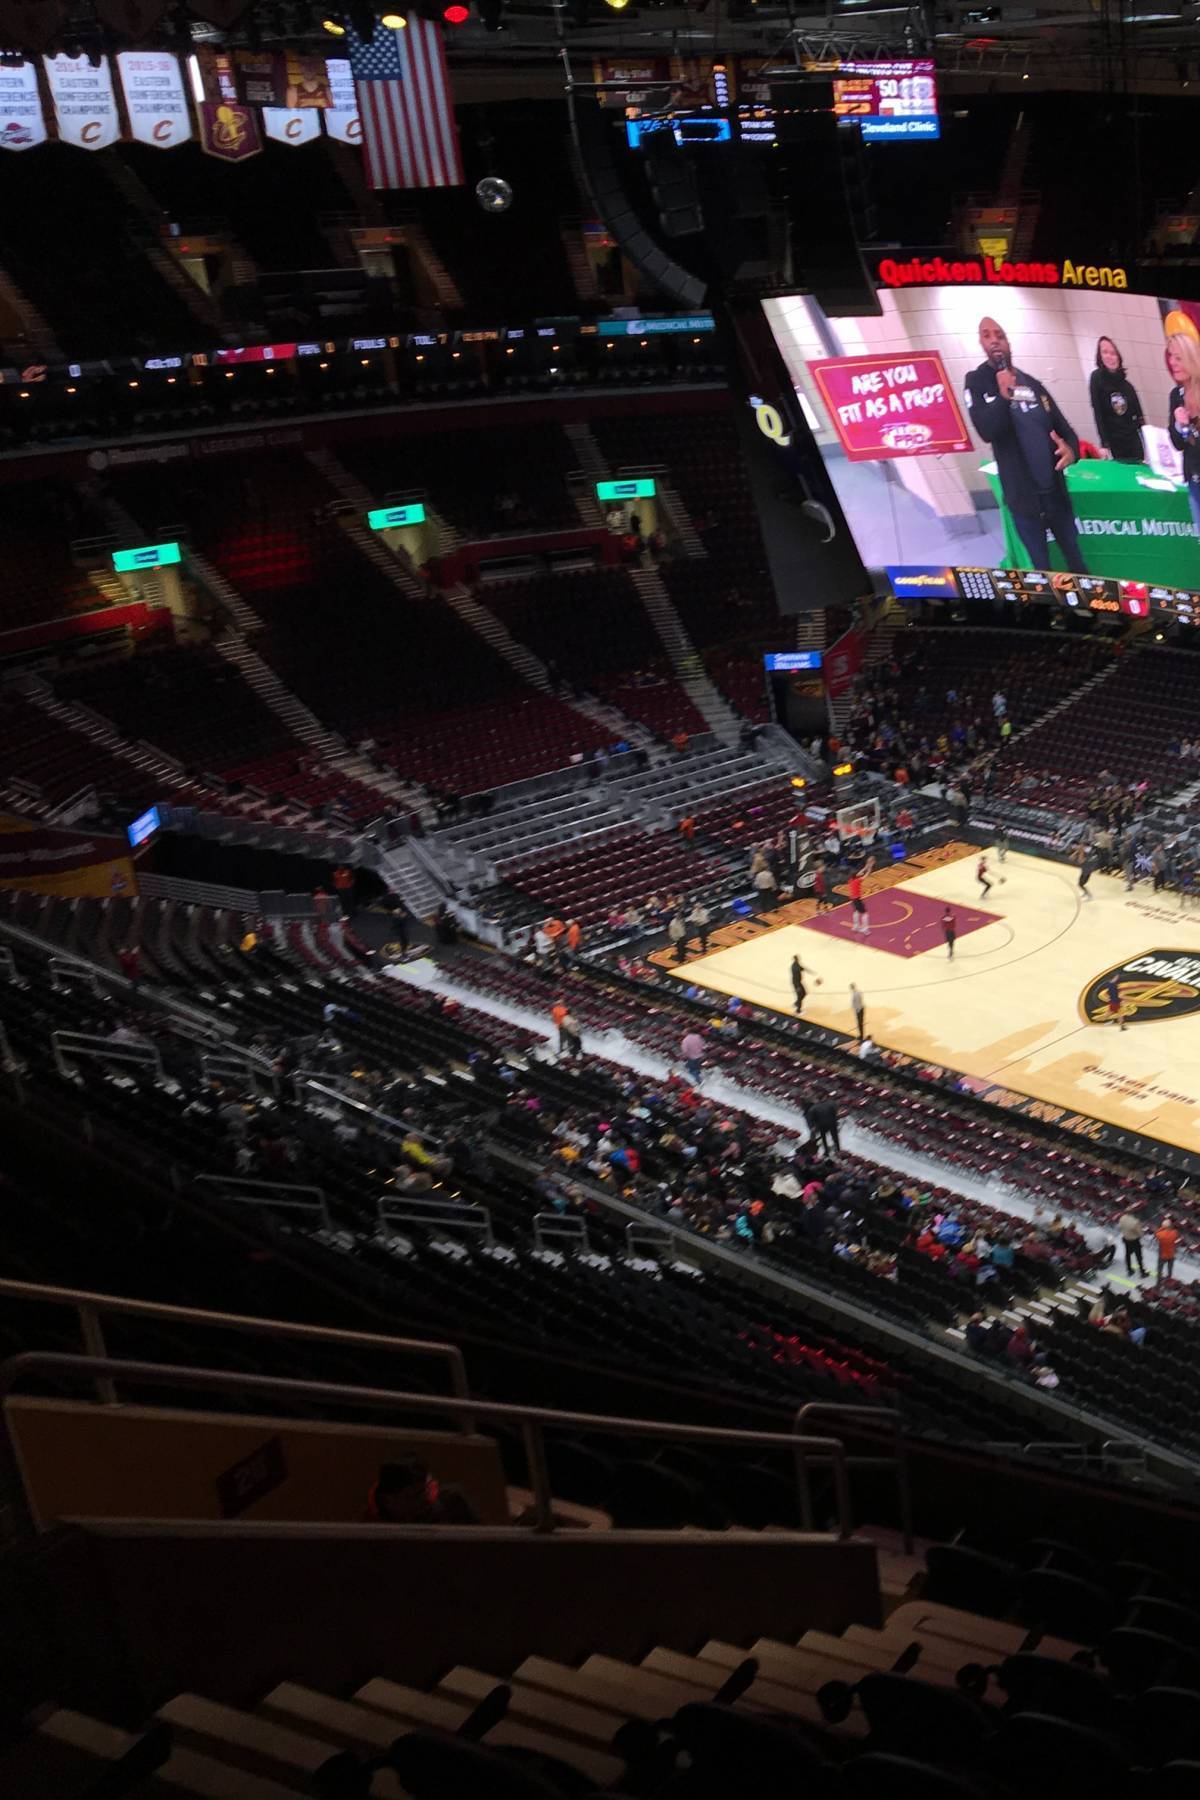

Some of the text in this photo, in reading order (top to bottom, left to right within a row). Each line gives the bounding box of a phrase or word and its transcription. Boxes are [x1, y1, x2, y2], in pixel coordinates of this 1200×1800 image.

[879, 256, 1128, 288] Quicken Loans Arena
[851, 364, 918, 395] ARE YOU
[837, 383, 944, 426] FIT AS A PRO?
[1124, 901, 1178, 920] Quicken
[1141, 911, 1181, 925] Arena
[1082, 1064, 1199, 1105] Quicken Loans
[1100, 1081, 1148, 1101] Arena
